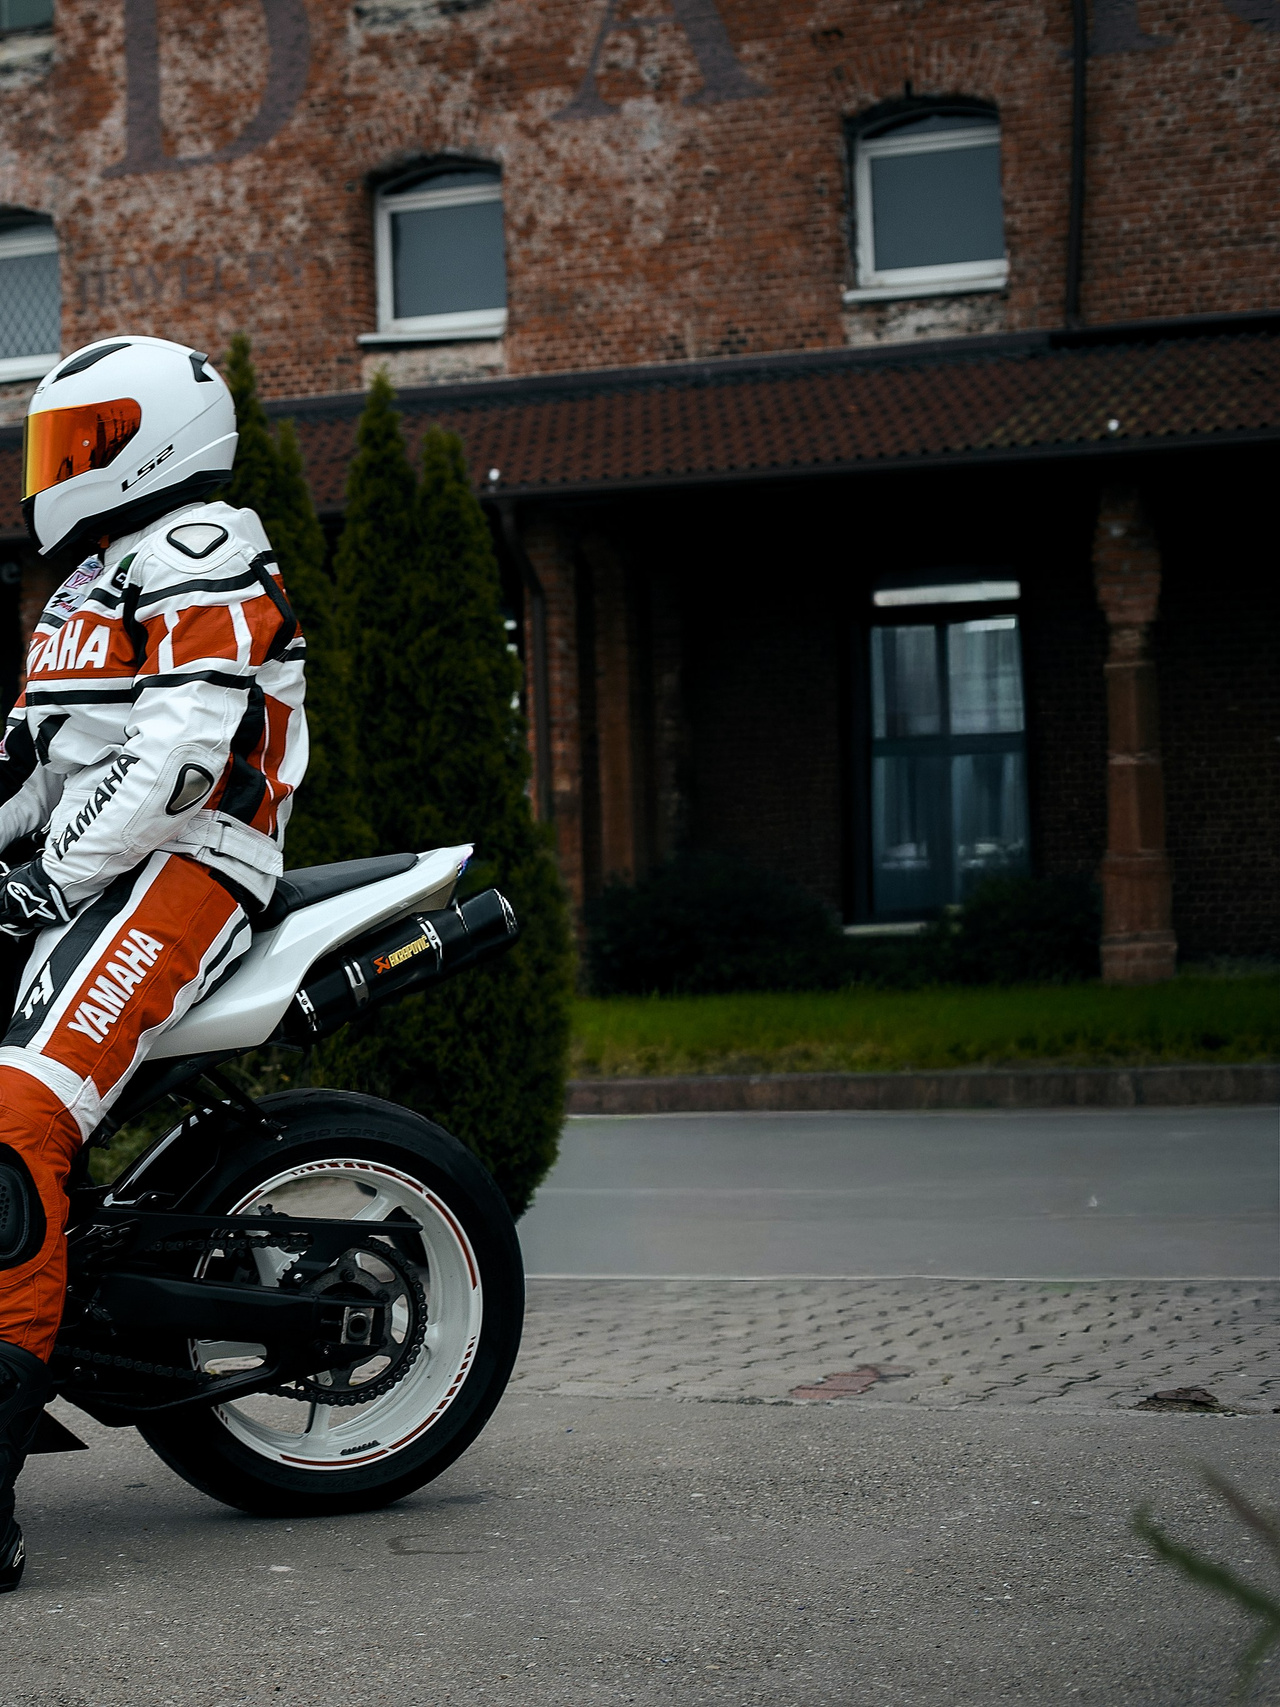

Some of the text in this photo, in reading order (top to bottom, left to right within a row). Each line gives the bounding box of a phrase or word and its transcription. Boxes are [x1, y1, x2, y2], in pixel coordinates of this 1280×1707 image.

[121, 443, 176, 493] LS2
[51, 754, 141, 861] YAMAHA
[66, 928, 165, 1044] YAMAHA
